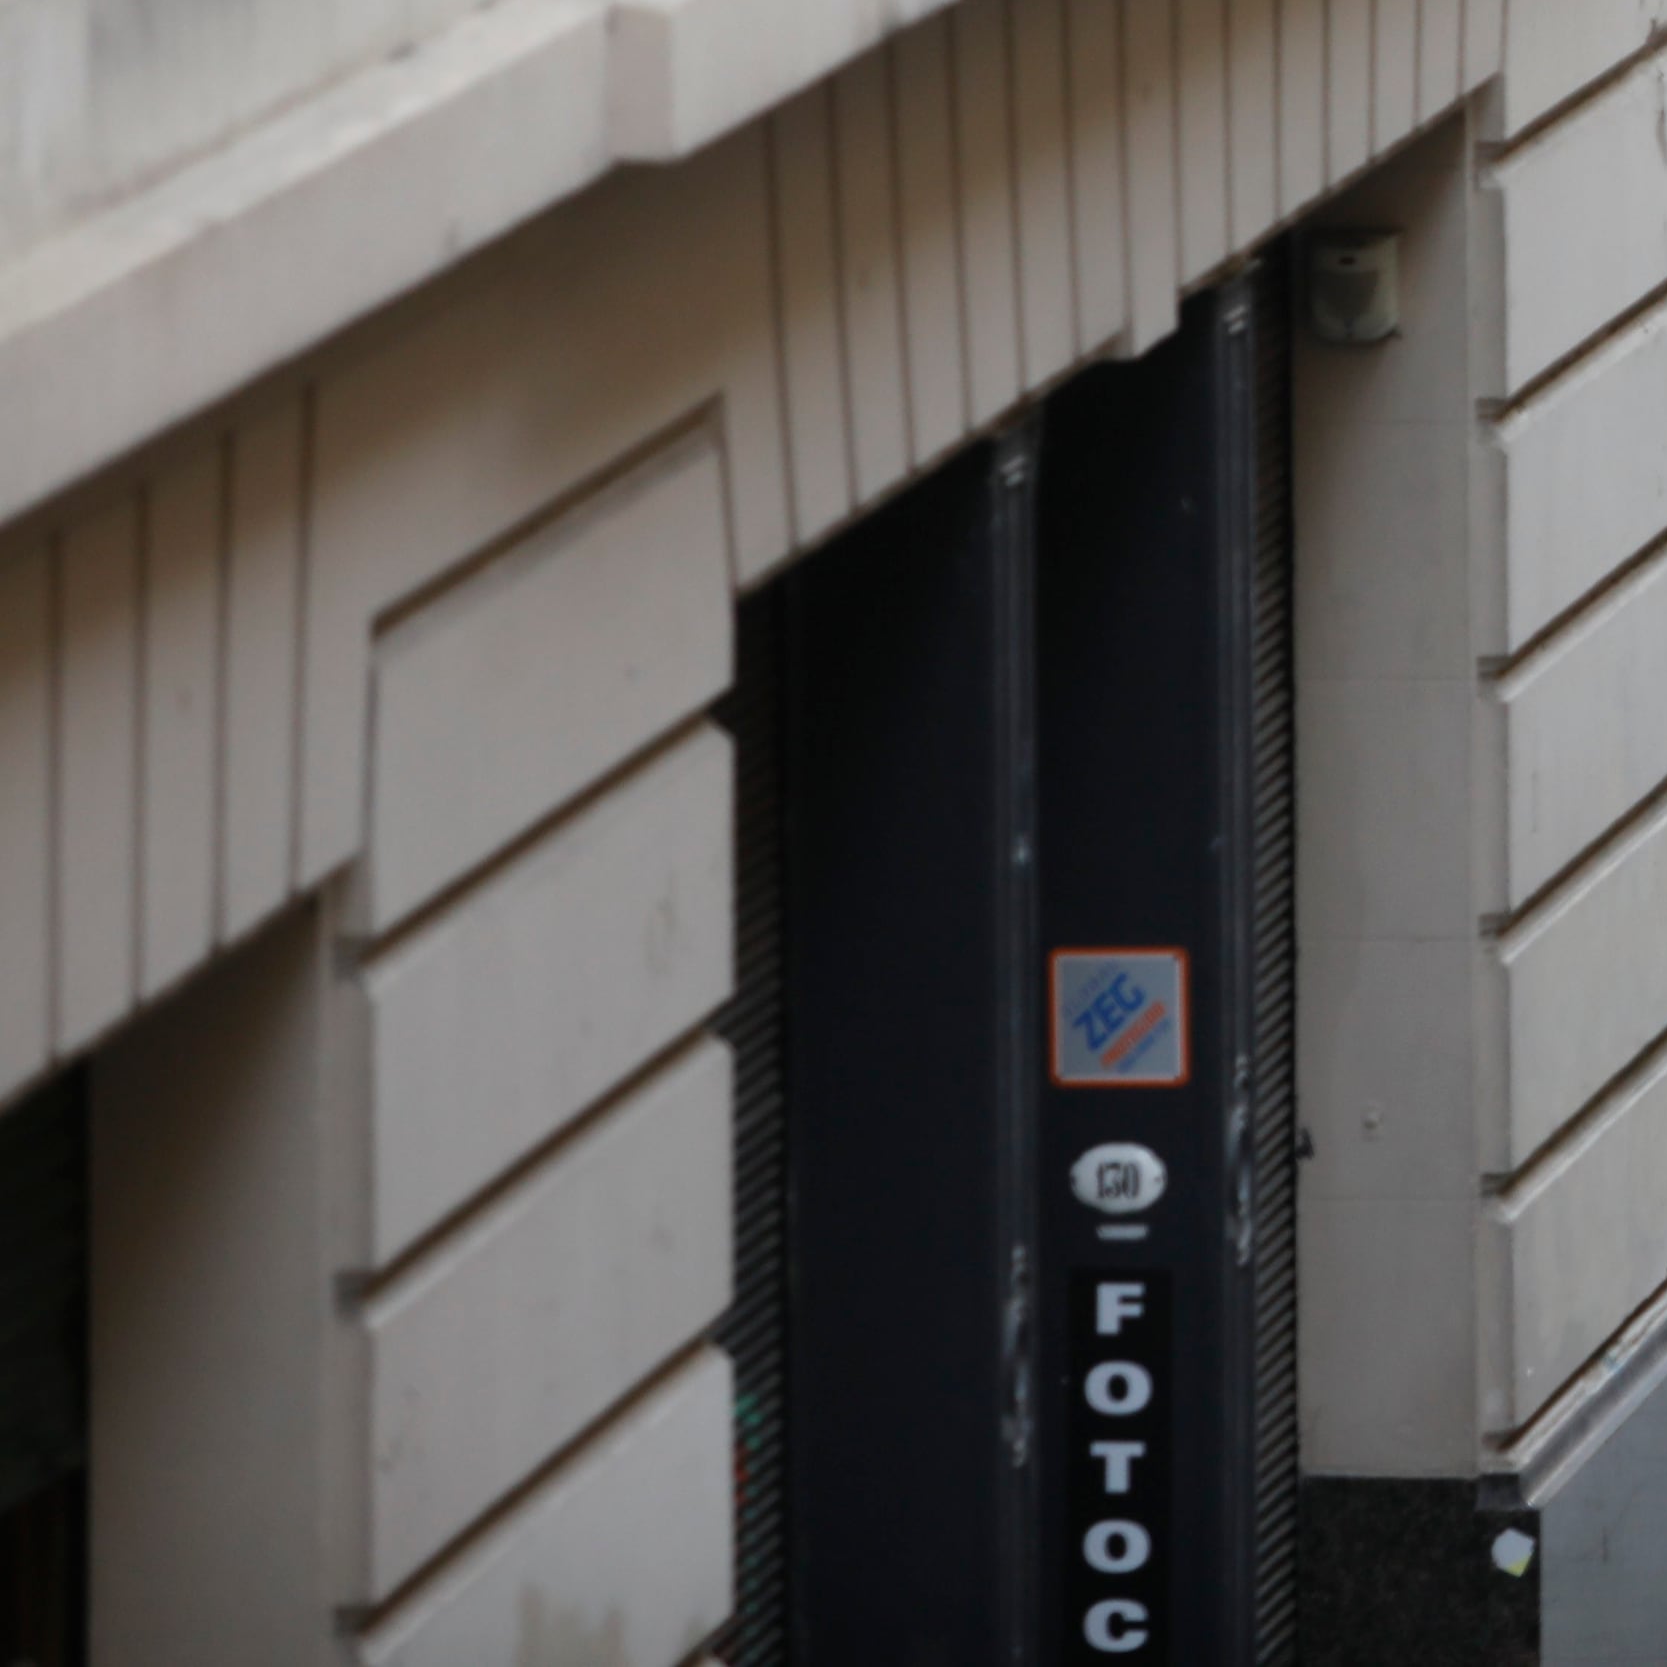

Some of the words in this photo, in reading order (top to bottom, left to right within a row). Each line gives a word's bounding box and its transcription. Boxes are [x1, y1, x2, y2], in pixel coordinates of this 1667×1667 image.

[1071, 970, 1147, 1052] ZEC
[1096, 1161, 1141, 1200] 130
[1083, 1282, 1153, 1653] FOTOC
